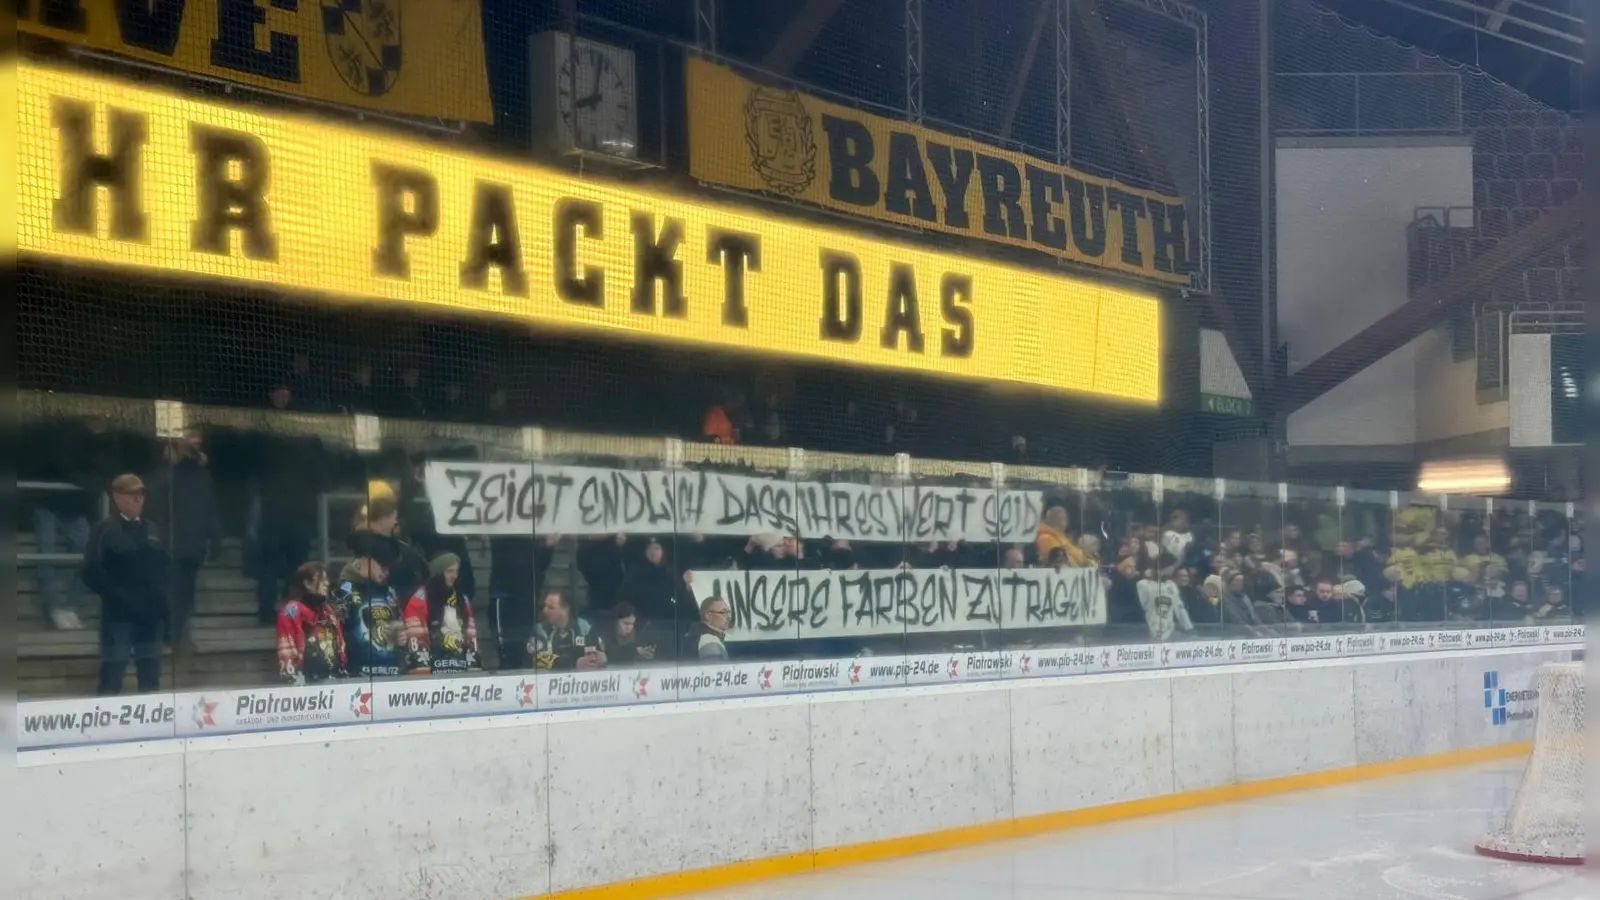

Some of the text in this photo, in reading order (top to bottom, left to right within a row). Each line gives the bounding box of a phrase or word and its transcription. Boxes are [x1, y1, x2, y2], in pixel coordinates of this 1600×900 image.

[821, 113, 1191, 274] BAYREUTH
[370, 157, 762, 328] PACKT
[818, 247, 974, 358] DAS
[717, 476, 798, 534] DASS
[887, 484, 977, 538] WERT
[983, 489, 1038, 537] SEID
[713, 571, 1099, 632] UNSERE FARBEN ZU TRAGEN!
[1117, 648, 1155, 662] Piotrowski
[1175, 647, 1223, 660] www.pio-24.de
[1241, 640, 1273, 653] Piotrowski
[782, 662, 839, 681] Piotrowski
[870, 658, 940, 677] www.pio-24.de
[967, 654, 1013, 670] Piotrowski
[1037, 652, 1095, 670] www.pio-24.de
[548, 674, 621, 696] Piotrowski
[660, 671, 748, 692] www.pio-24.de
[236, 688, 335, 715] Piotrowski
[388, 684, 503, 709] www.pio-24.de
[24, 703, 175, 733] www.pio-24.de
